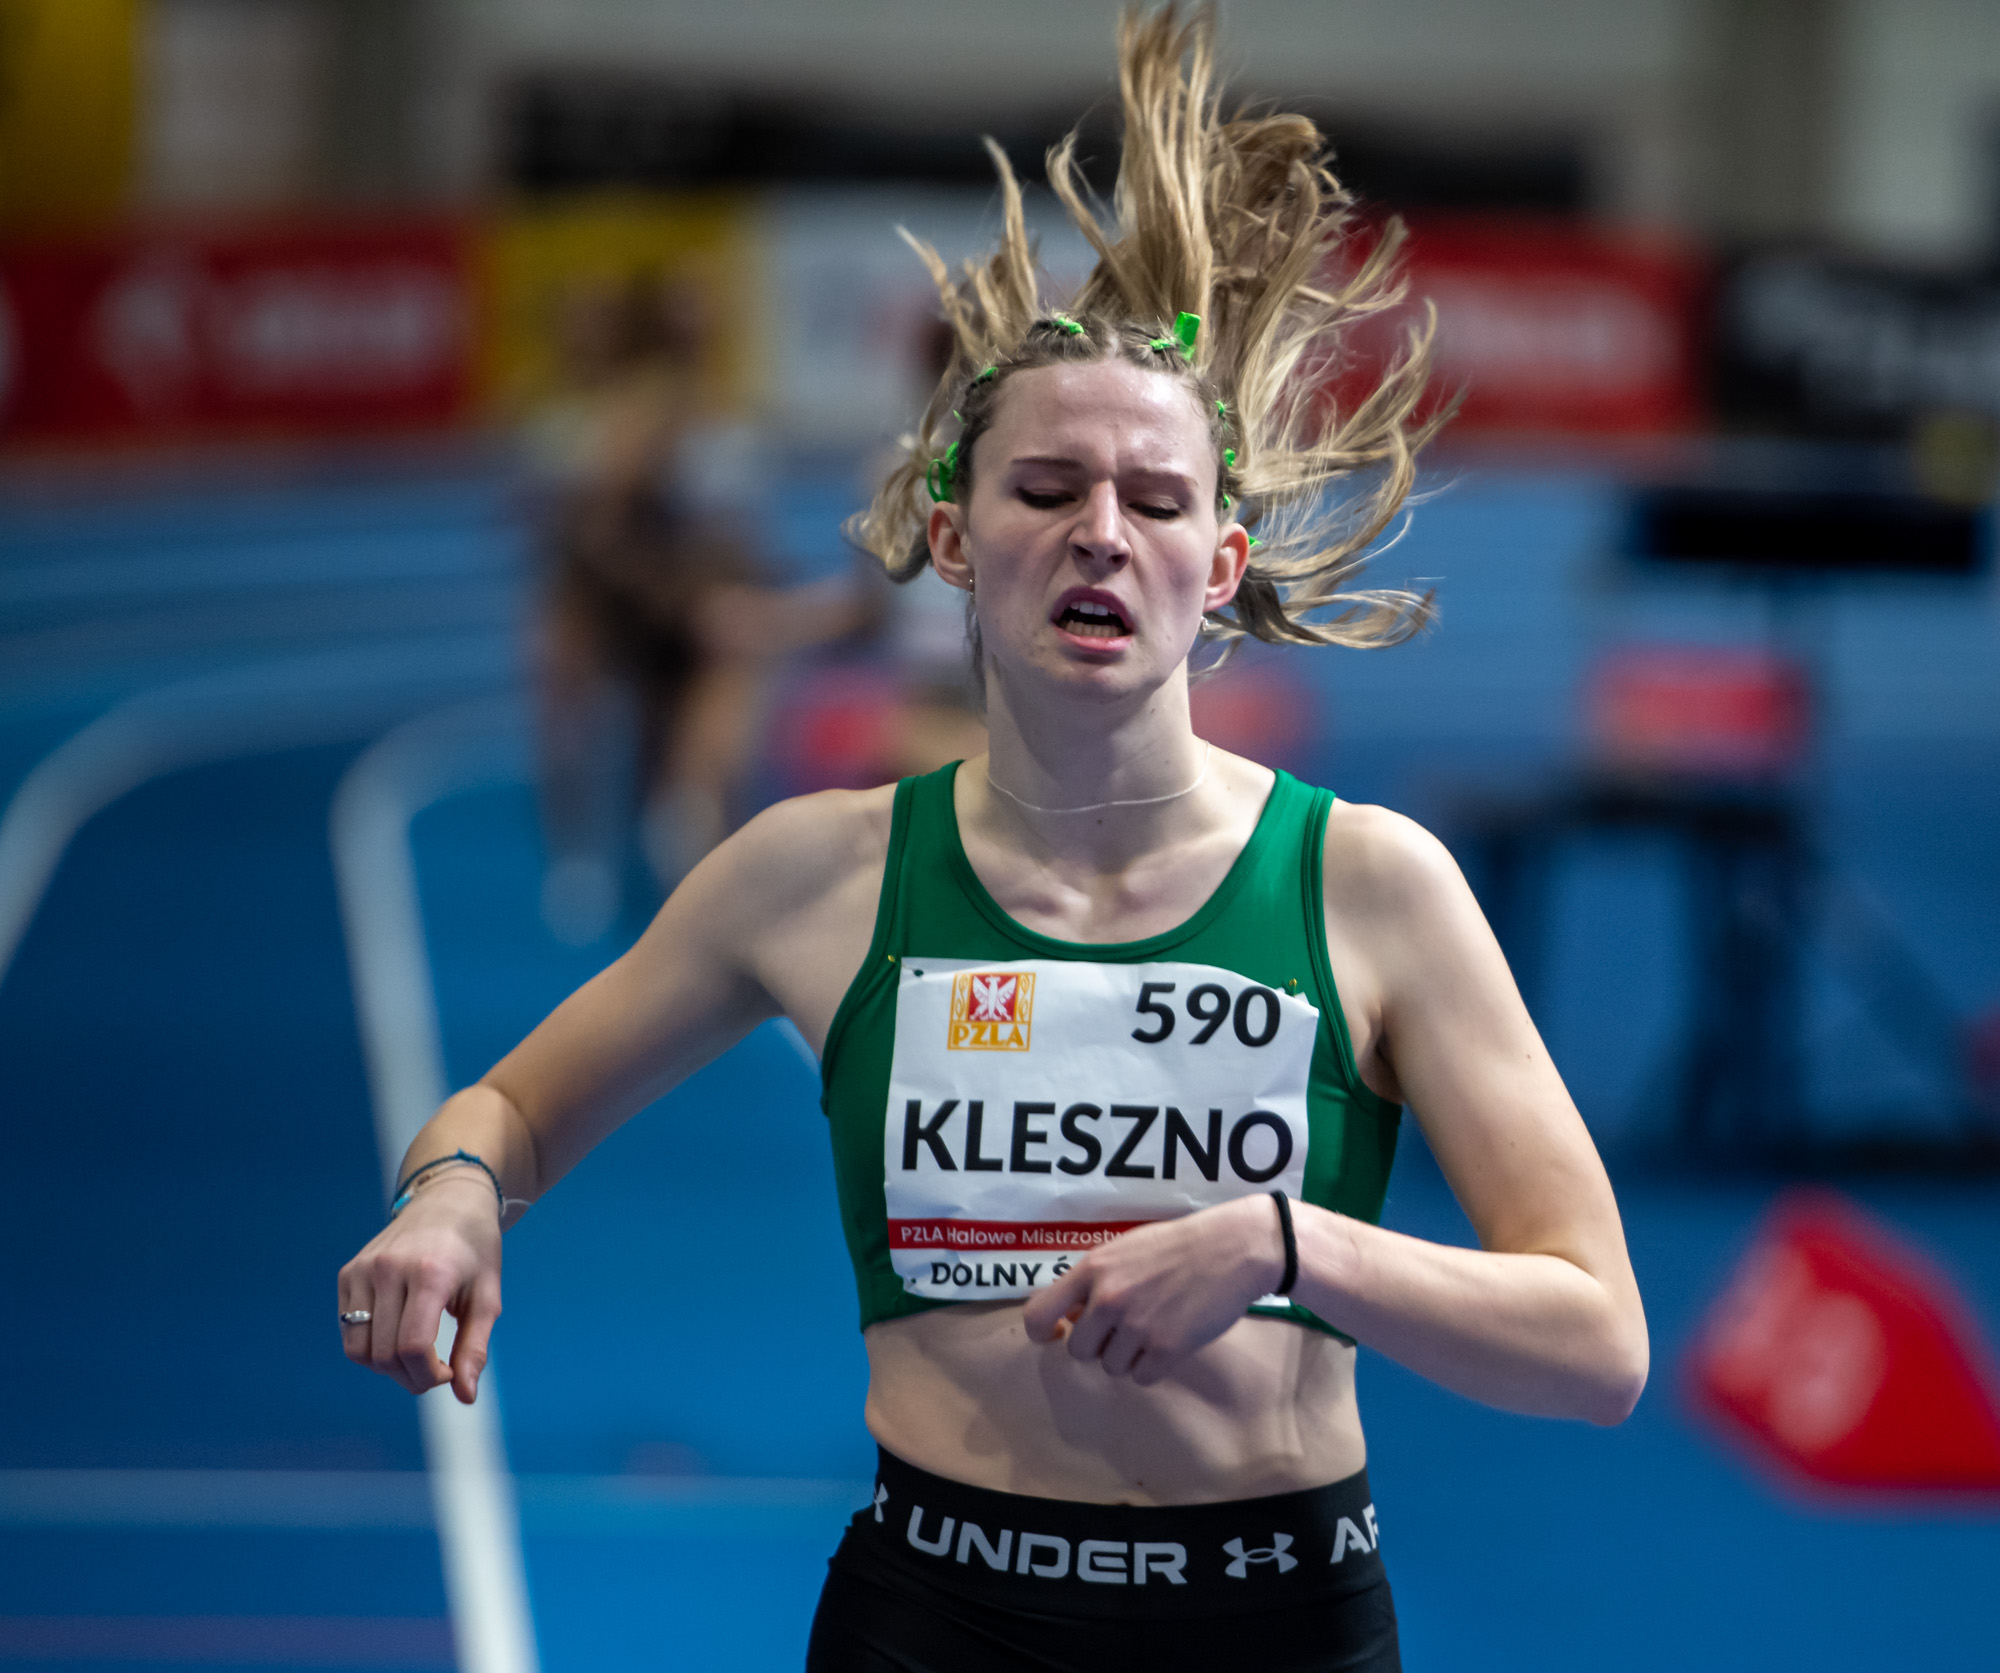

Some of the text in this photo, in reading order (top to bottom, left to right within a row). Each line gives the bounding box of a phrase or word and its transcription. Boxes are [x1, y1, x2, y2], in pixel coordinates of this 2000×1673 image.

[952, 1023, 1025, 1047] PZLA
[1131, 982, 1281, 1047] 590
[902, 1099, 1293, 1183] KLESZNO
[901, 1226, 943, 1242] PZLA
[947, 1226, 1017, 1245] Halowe
[931, 1261, 1042, 1287] DOLNY
[907, 1505, 1188, 1585] UNDER
